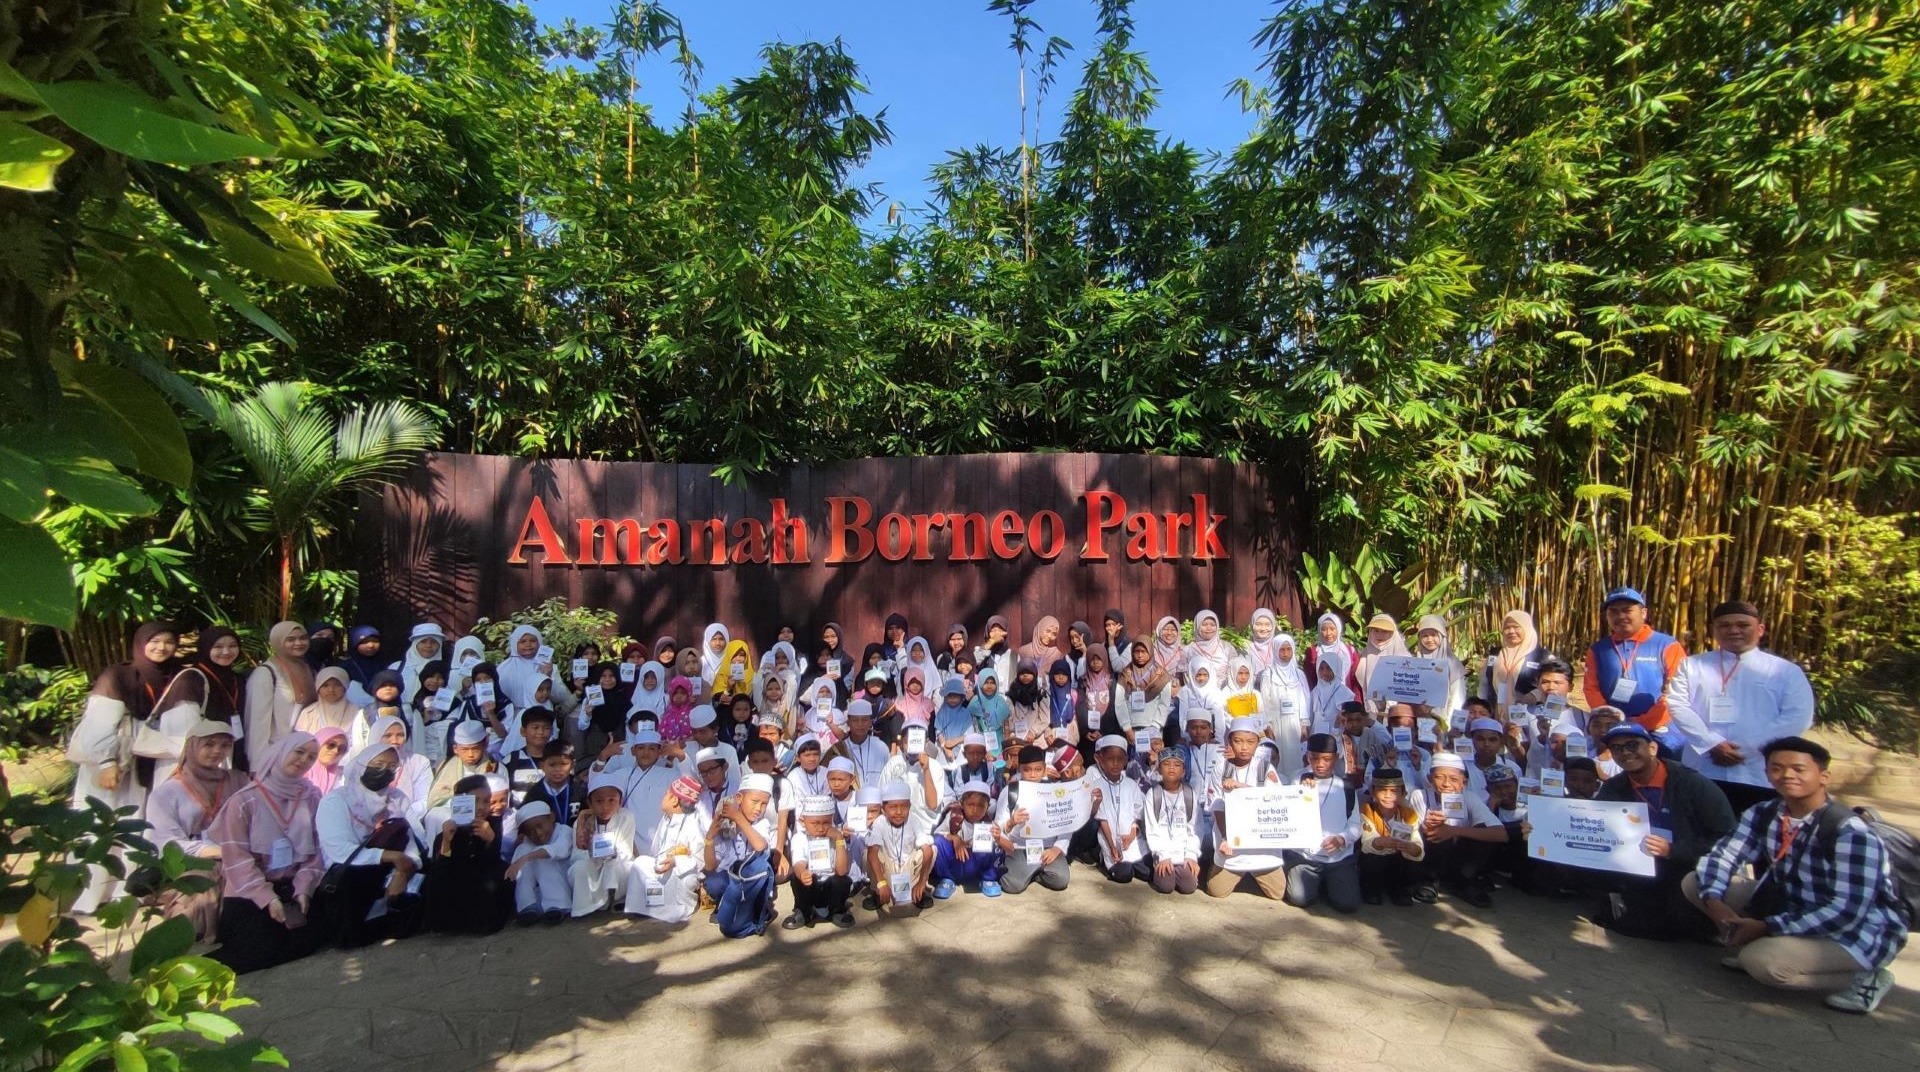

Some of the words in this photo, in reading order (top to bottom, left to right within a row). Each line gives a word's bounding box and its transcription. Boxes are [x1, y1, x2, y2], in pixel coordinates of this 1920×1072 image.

[507, 495, 812, 565] Amanah
[824, 496, 1067, 563] Borneo
[1079, 490, 1231, 560] Park
[1393, 671, 1420, 681] berbagi
[1257, 808, 1288, 817] berbagi
[1257, 816, 1289, 824] bahagia
[1570, 816, 1606, 828] berbagi
[1570, 823, 1606, 834] bahagia
[1552, 831, 1585, 842] Wisata
[1587, 836, 1625, 847] Bahagia
